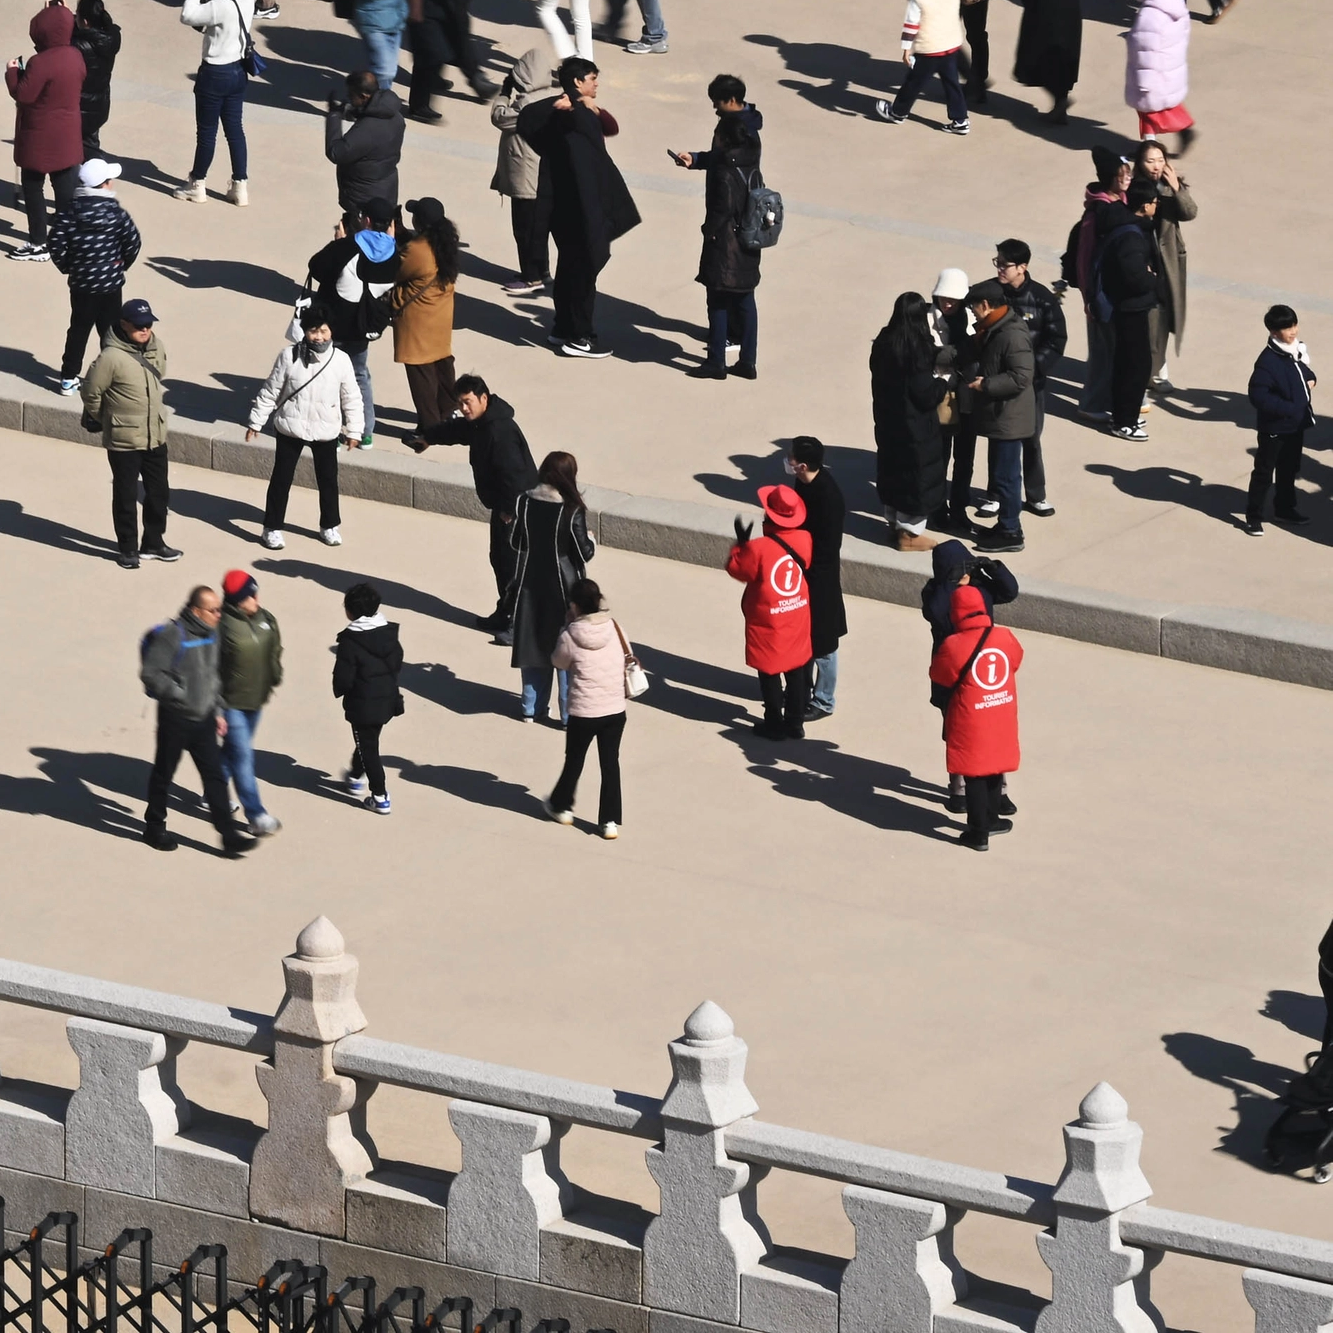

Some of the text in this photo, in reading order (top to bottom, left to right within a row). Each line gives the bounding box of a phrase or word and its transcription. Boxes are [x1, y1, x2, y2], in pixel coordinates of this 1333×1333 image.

[770, 599, 808, 615] INFORMATION
[778, 595, 801, 607] TOURIST
[975, 695, 1014, 710] INFORMATION
[983, 690, 1008, 702] TOURIST
